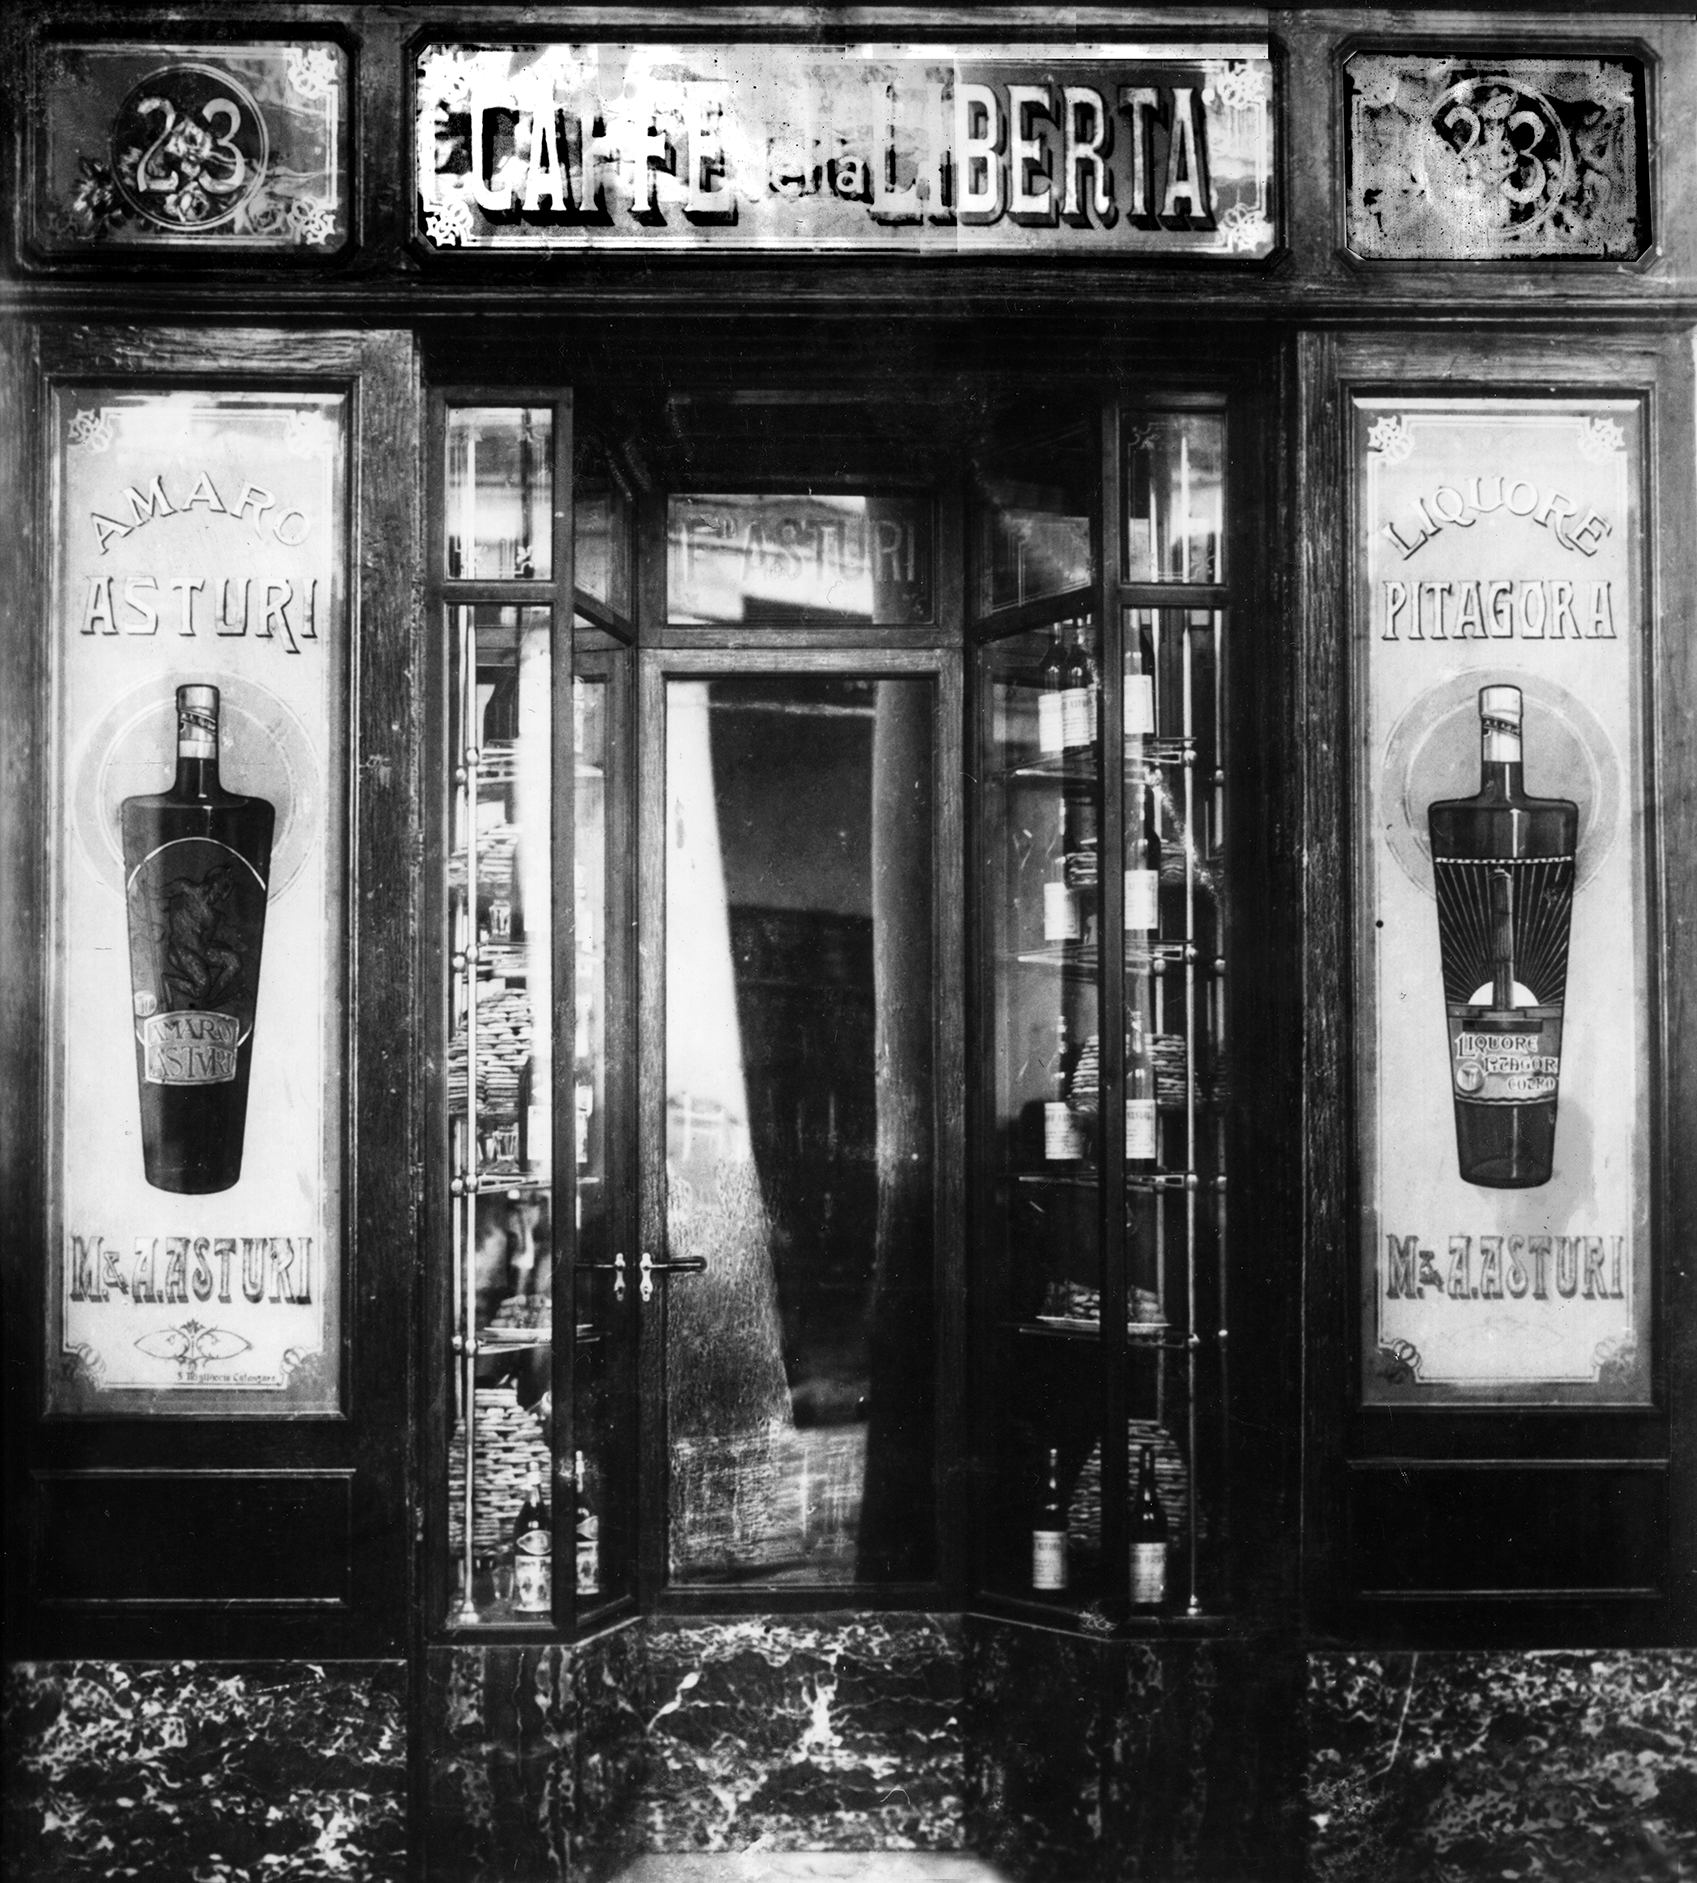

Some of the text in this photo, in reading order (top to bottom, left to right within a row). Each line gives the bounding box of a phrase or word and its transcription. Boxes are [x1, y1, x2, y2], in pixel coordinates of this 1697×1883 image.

[137, 97, 245, 193] 23
[90, 470, 311, 556] AMARO
[1380, 476, 1613, 561] LIQUORE
[79, 576, 318, 655] ASTURI
[1381, 580, 1618, 641] PITAGORA
[154, 1018, 233, 1042] AMARO
[1455, 1034, 1539, 1058] LIQUORE
